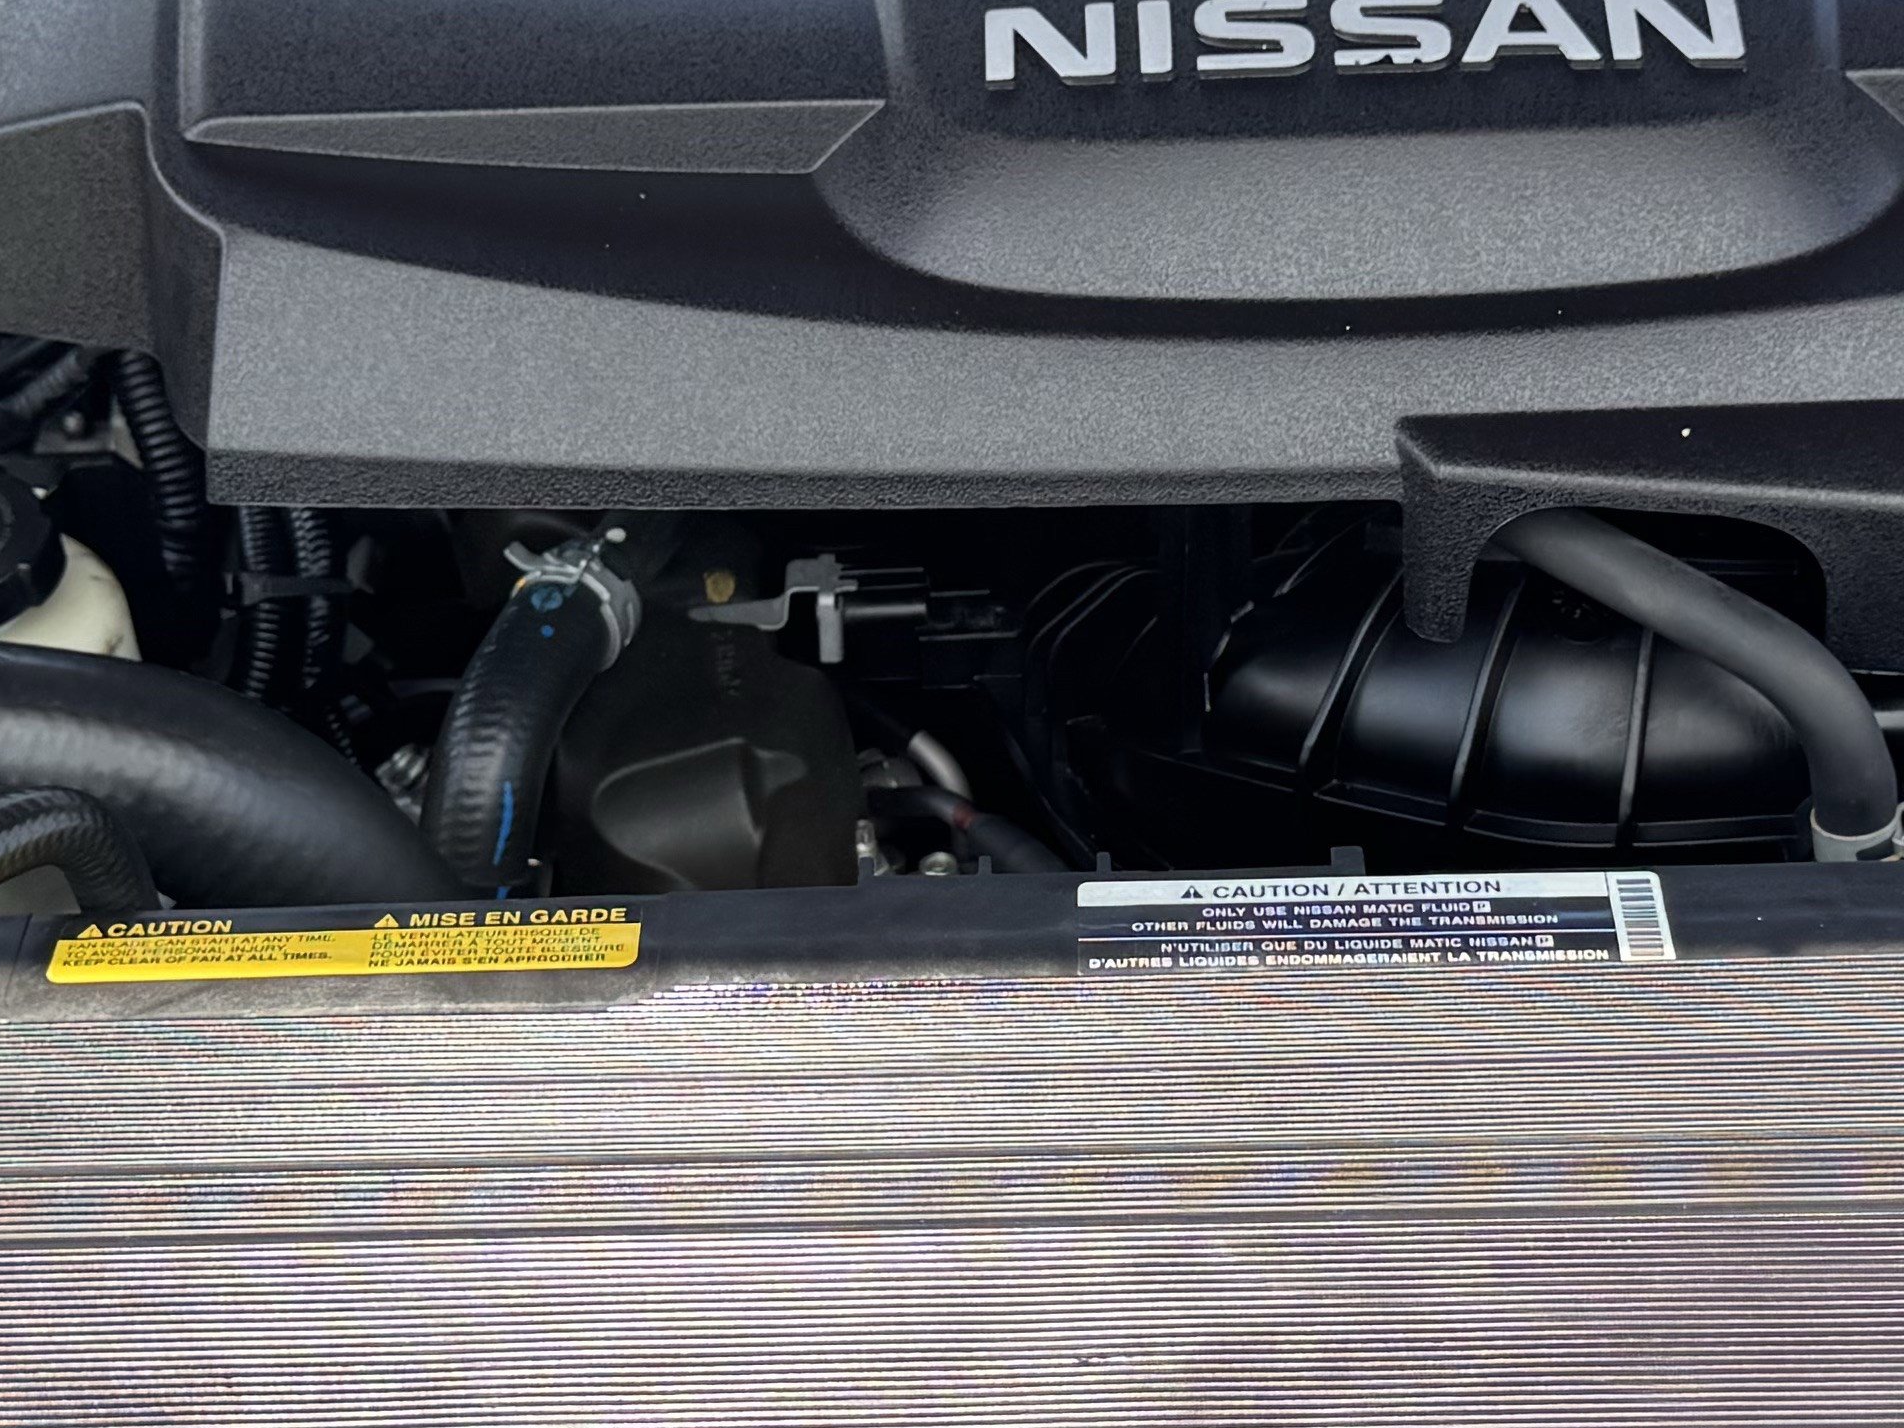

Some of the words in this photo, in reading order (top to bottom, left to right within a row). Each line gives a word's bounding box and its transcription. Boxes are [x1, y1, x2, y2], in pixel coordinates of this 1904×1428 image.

[1213, 884, 1329, 899] CAUTION
[1354, 881, 1501, 896] ATTENTION
[409, 912, 476, 927] MISE
[484, 911, 521, 925] EN
[529, 907, 627, 923] GARDE
[1202, 907, 1246, 918] ONLY
[1253, 906, 1287, 917] USE
[1293, 905, 1356, 916] NISSAN
[1363, 903, 1414, 914] MATIC
[1422, 902, 1470, 913] FLUID
[107, 919, 232, 938] CAUTION
[1131, 921, 1188, 932] OTHER
[1196, 921, 1255, 931] FLUIDS
[1262, 919, 1303, 929] WILL
[1310, 918, 1381, 928] DAMAGE
[1388, 916, 1422, 926] THE
[1429, 914, 1559, 925] TRANSMISSION
[399, 929, 507, 939] VENTILATEUR
[513, 928, 576, 937] RISQUE
[579, 927, 600, 936] DE
[485, 937, 525, 946] TOUT
[531, 936, 600, 945] MOMENT
[68, 942, 98, 951] FAN
[100, 940, 148, 949] BLADE
[154, 939, 186, 947] CAN
[191, 937, 237, 945] START
[240, 936, 259, 944] AT
[262, 935, 293, 943] ANY
[370, 950, 416, 959] POUR
[485, 945, 538, 955] TOUTE
[541, 943, 625, 953] BLESSURE
[1161, 942, 1253, 952] N'UTILISER
[1261, 941, 1297, 951] QUE
[1303, 940, 1327, 950] DU
[1335, 939, 1403, 950] LIQUIDE
[1409, 937, 1462, 948] MATIC
[1468, 936, 1533, 947] NISSAN
[63, 958, 105, 967] KEEP
[107, 957, 160, 965] CLEAR
[165, 955, 187, 963] OF
[191, 954, 221, 962] FAN
[224, 953, 243, 961] AT
[247, 953, 277, 961] ALL
[67, 951, 87, 959] TO
[90, 949, 137, 957] AVOID
[142, 946, 226, 956] PERSONAL
[368, 959, 391, 968] NE
[394, 957, 457, 966] JAMAIS
[462, 956, 499, 965] S'EN
[504, 953, 605, 963] APPROCHER
[1089, 957, 1172, 968] D'AUTRES
[1179, 955, 1259, 967] LIQUIDES
[1265, 951, 1440, 966] ENDOMMAGERAIENT
[1447, 951, 1471, 962] LA
[1477, 949, 1609, 961] TRANSMISSION
